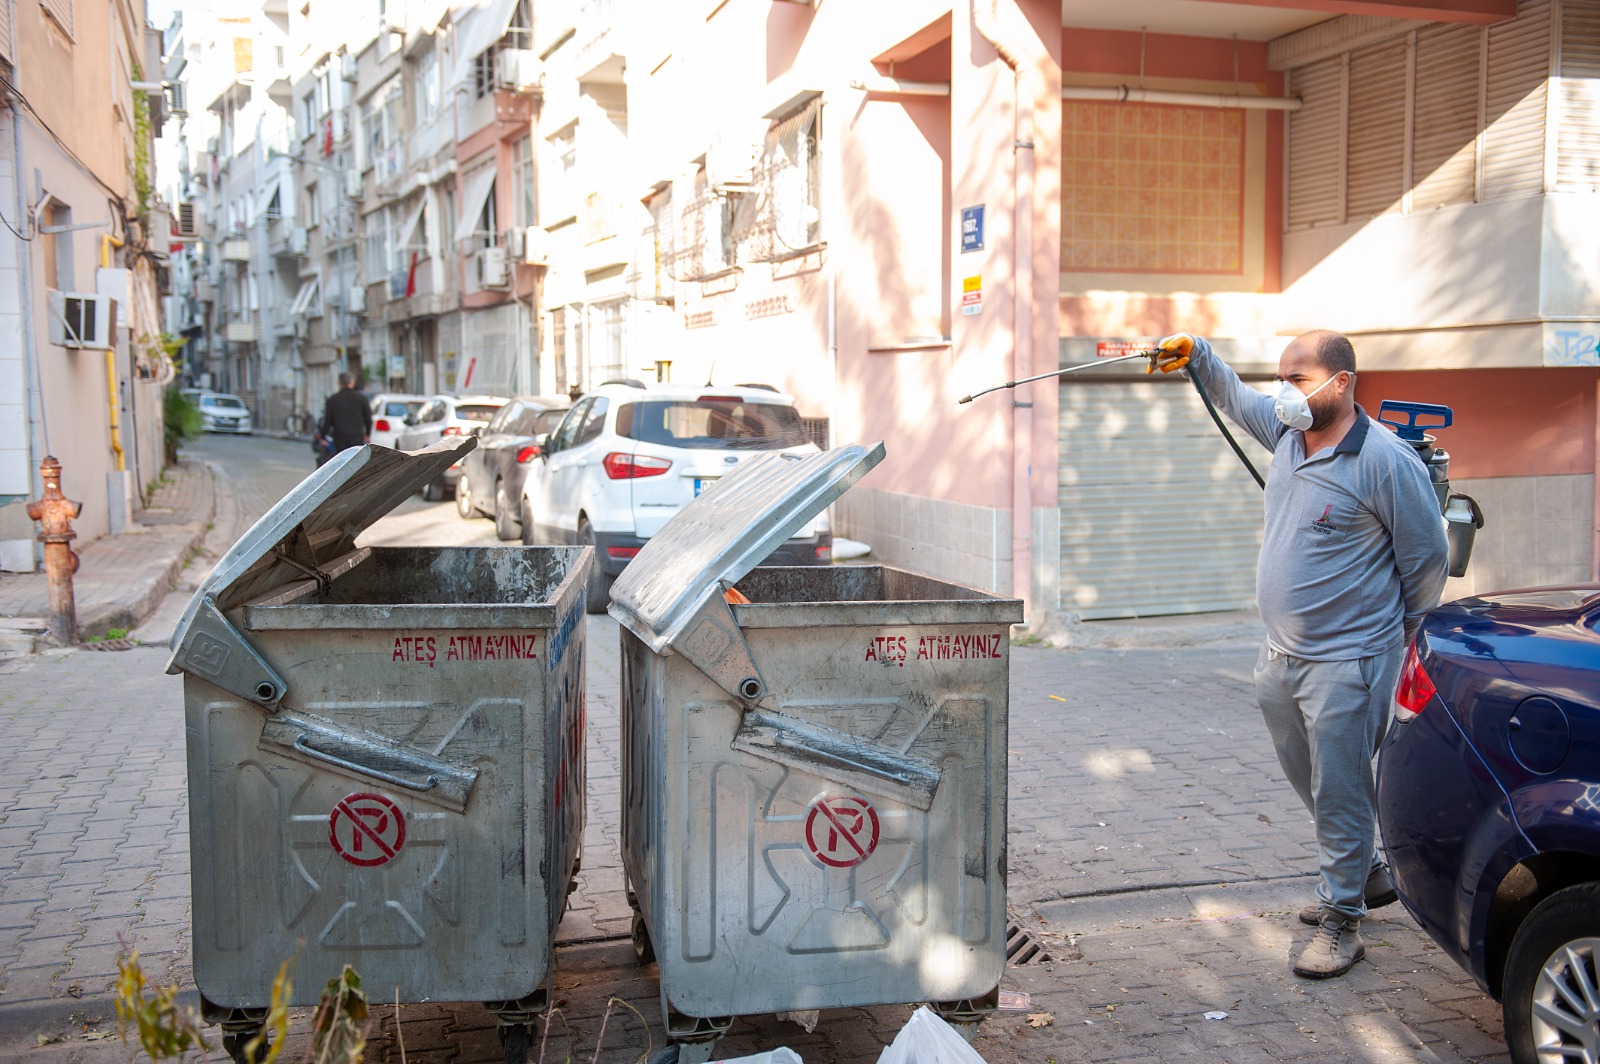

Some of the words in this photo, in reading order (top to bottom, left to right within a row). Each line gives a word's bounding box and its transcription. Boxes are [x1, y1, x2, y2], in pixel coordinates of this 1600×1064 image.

[392, 636, 437, 668] ATEŞ
[447, 634, 537, 661] ATMAYINIZ
[865, 635, 907, 668] ATEŞ
